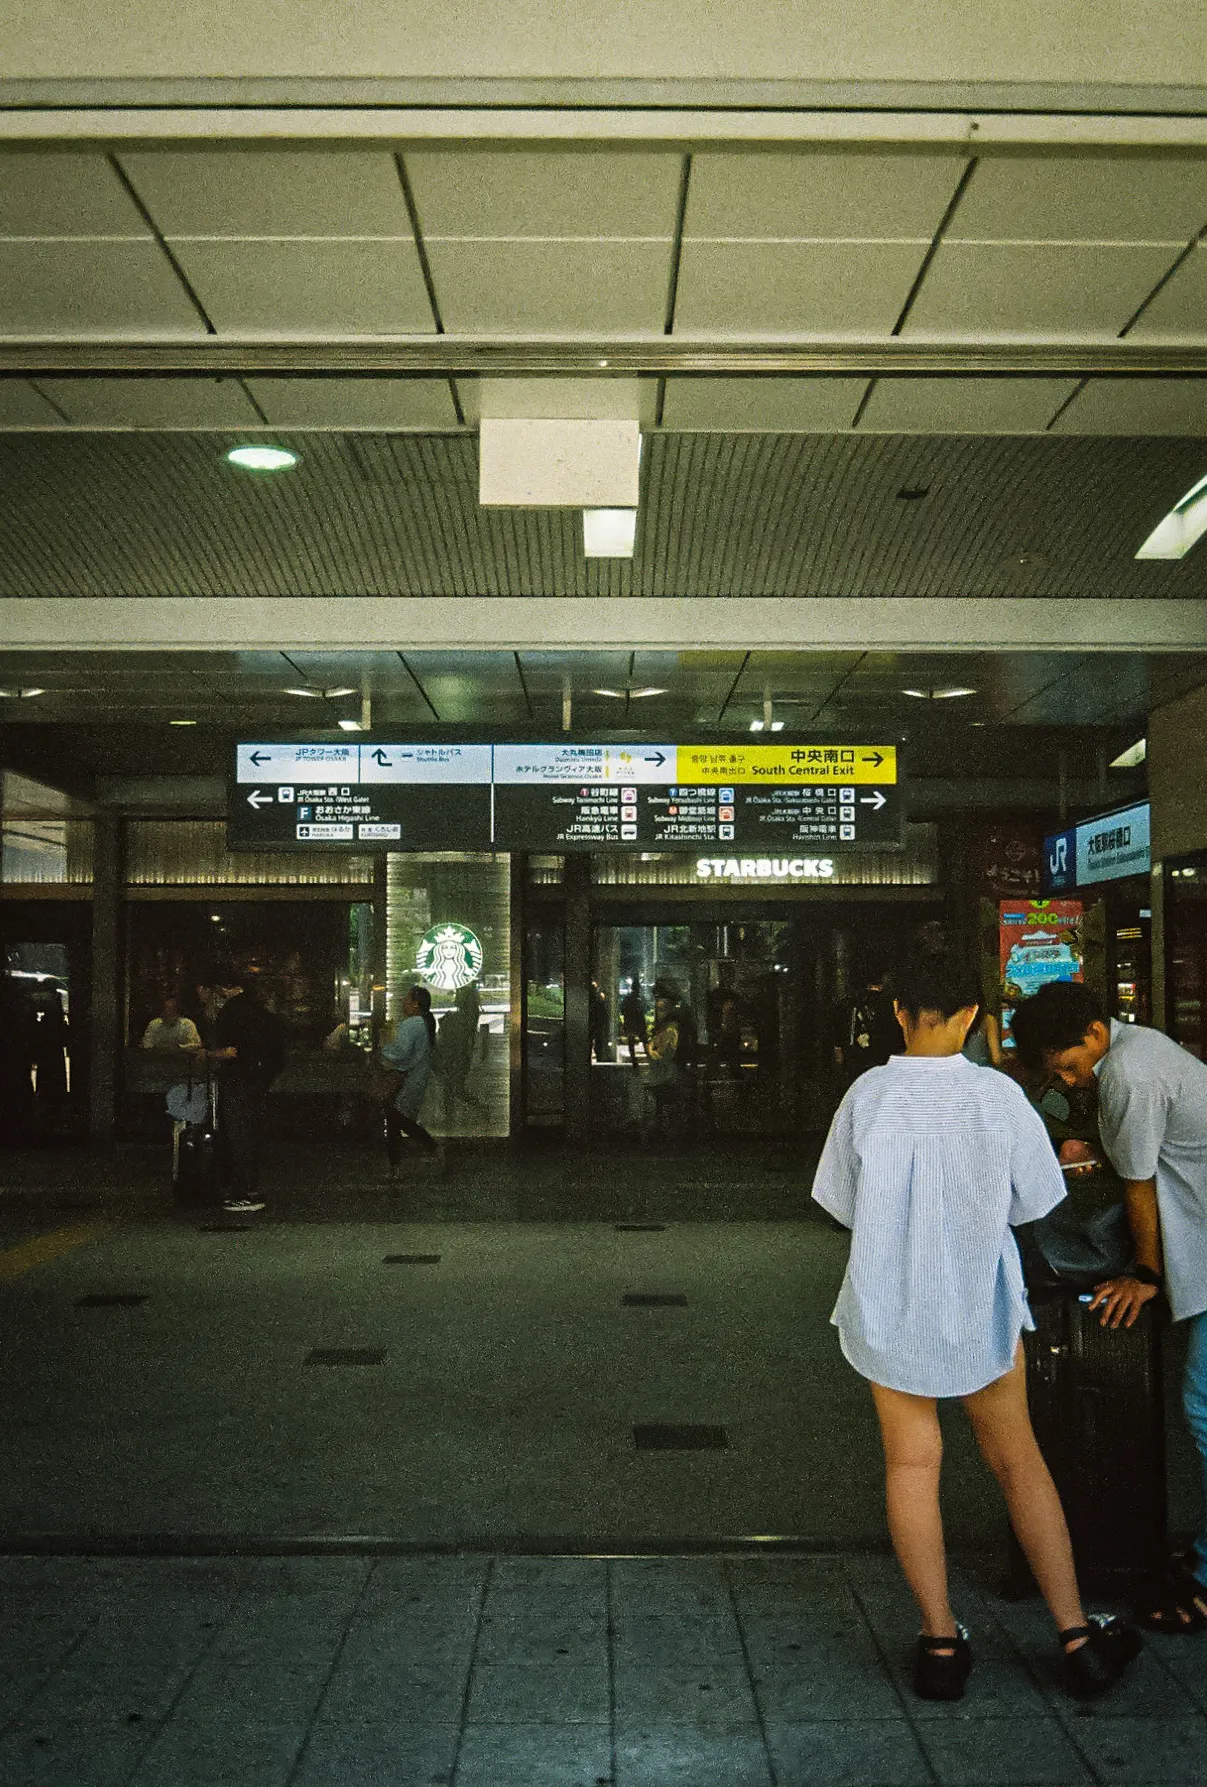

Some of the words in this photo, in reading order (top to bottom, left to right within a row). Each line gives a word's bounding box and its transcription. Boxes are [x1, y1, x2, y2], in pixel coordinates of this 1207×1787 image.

[416, 748, 462, 756] シャトルバス
[791, 749, 855, 763] 中央南口
[702, 766, 746, 776] 中央南出口
[752, 765, 786, 775] South
[788, 765, 830, 775] Central
[833, 765, 855, 775] Exit
[300, 806, 309, 819] F
[315, 805, 372, 815] おおさか東線
[603, 814, 619, 822] Line
[566, 824, 619, 834] JR高速バス
[663, 824, 716, 834] JR北新地駅
[556, 833, 565, 841] JR
[566, 833, 605, 842] Expressway
[606, 833, 619, 841] Bus
[665, 833, 702, 841] Kitashinchi
[1049, 837, 1067, 876] JR
[696, 857, 834, 878] STARBUCKS
[1027, 912, 1059, 926] 200
